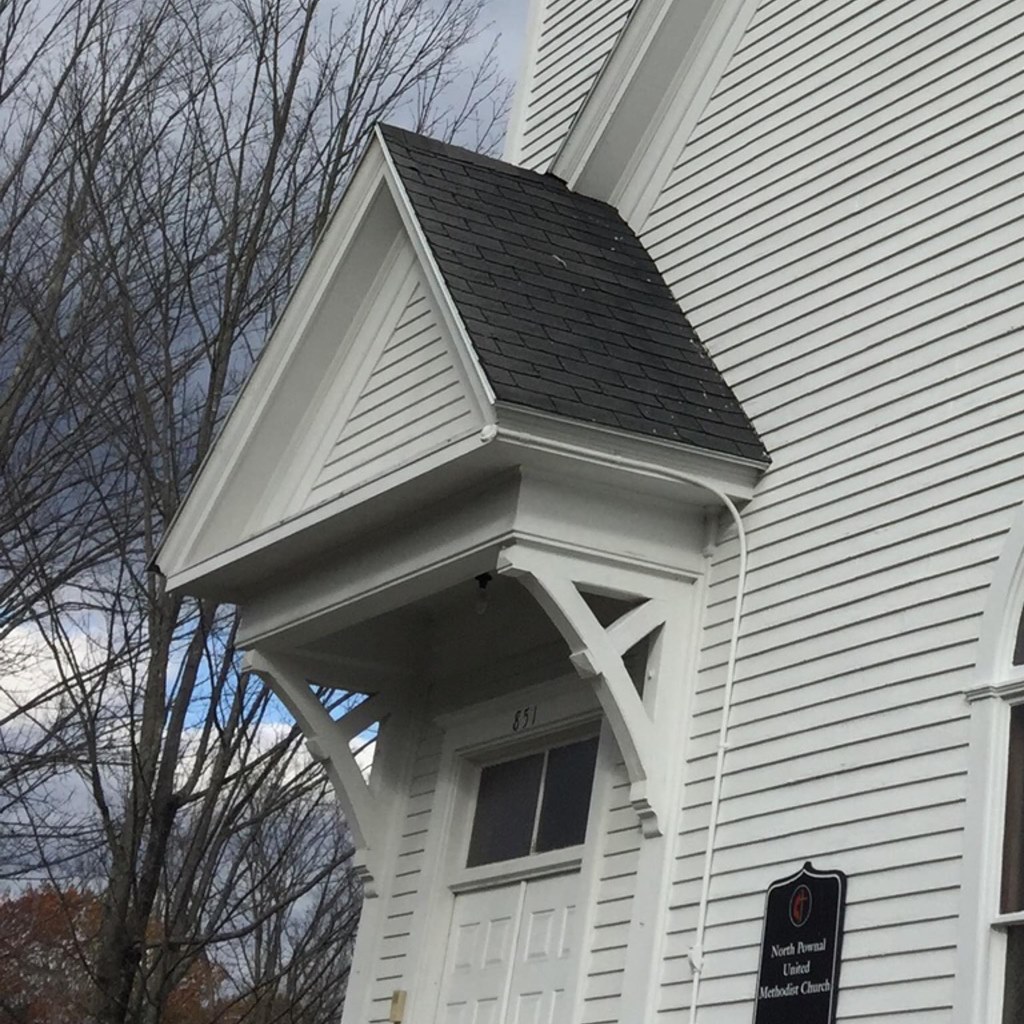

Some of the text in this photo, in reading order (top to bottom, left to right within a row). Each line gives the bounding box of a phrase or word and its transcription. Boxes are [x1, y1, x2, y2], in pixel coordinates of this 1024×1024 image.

[512, 704, 538, 732] 851
[771, 938, 827, 959] North Pownal
[783, 961, 811, 977] United
[759, 978, 831, 1000] Methodist Church
